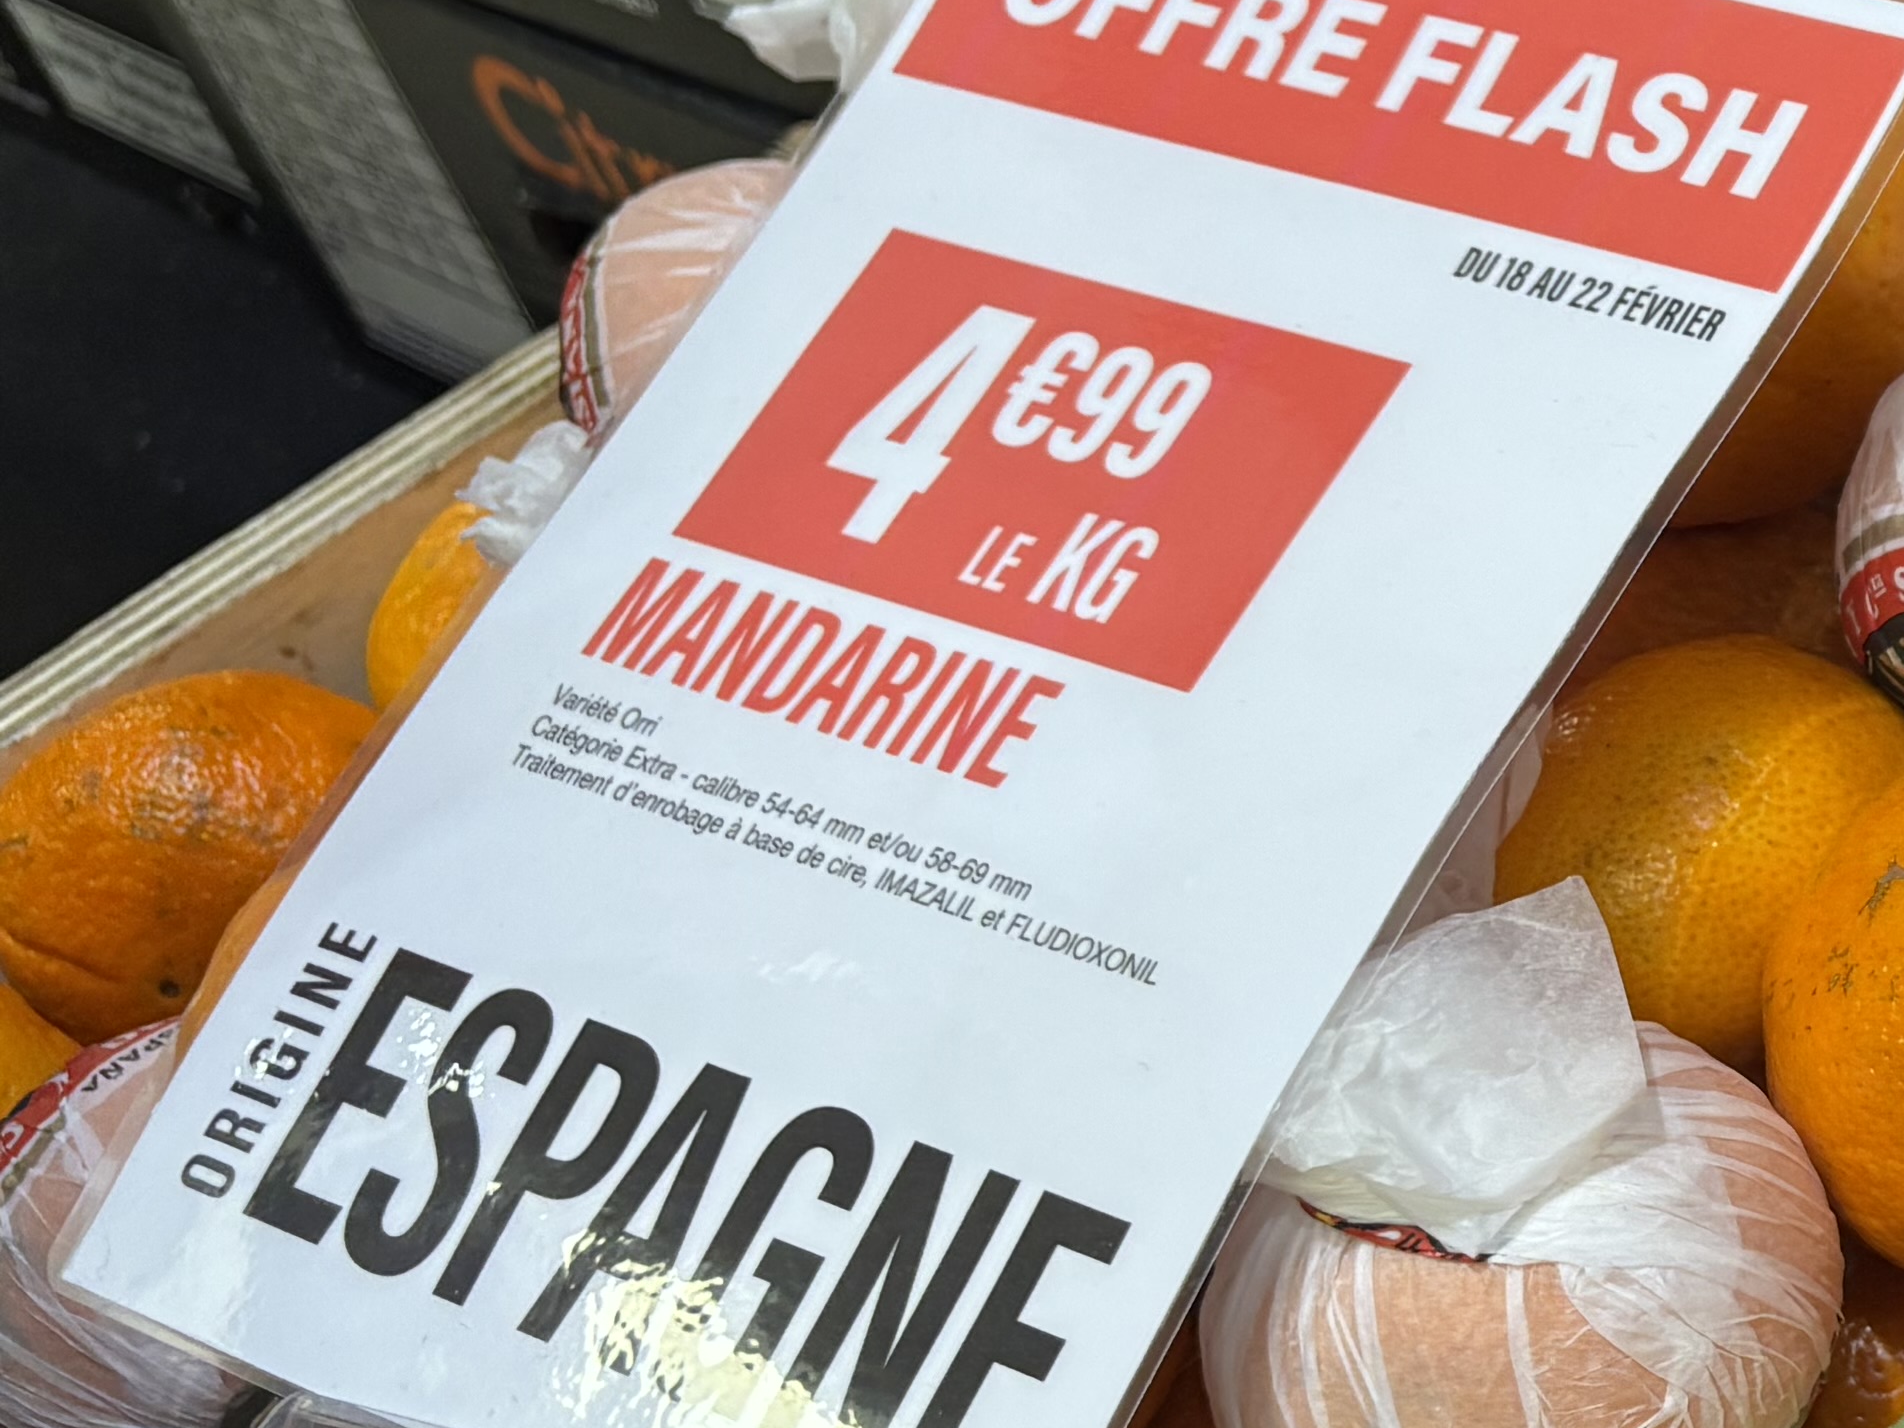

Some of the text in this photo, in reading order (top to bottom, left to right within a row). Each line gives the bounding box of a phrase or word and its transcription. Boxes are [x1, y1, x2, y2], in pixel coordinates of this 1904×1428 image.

[1374, 15, 1808, 199] FLASH
[1452, 246, 1727, 343] DU 18 AU 22 FÉVRIER
[957, 512, 1160, 625] LE KG
[551, 682, 622, 724] Variété
[582, 557, 1067, 789] MANDARINE
[510, 743, 1160, 987] Traitement d'enrobage à base de cire, IMAZALIL et FLUDIOXONIL
[531, 714, 623, 762] Catégorie
[624, 744, 678, 784] Extra
[691, 771, 761, 810] calibre
[761, 791, 825, 829] 54-64
[822, 816, 866, 845] mm
[866, 830, 924, 864] et/ou
[923, 845, 990, 886] 58-69
[988, 872, 1033, 902] mm
[181, 919, 379, 1197] ORIGINE
